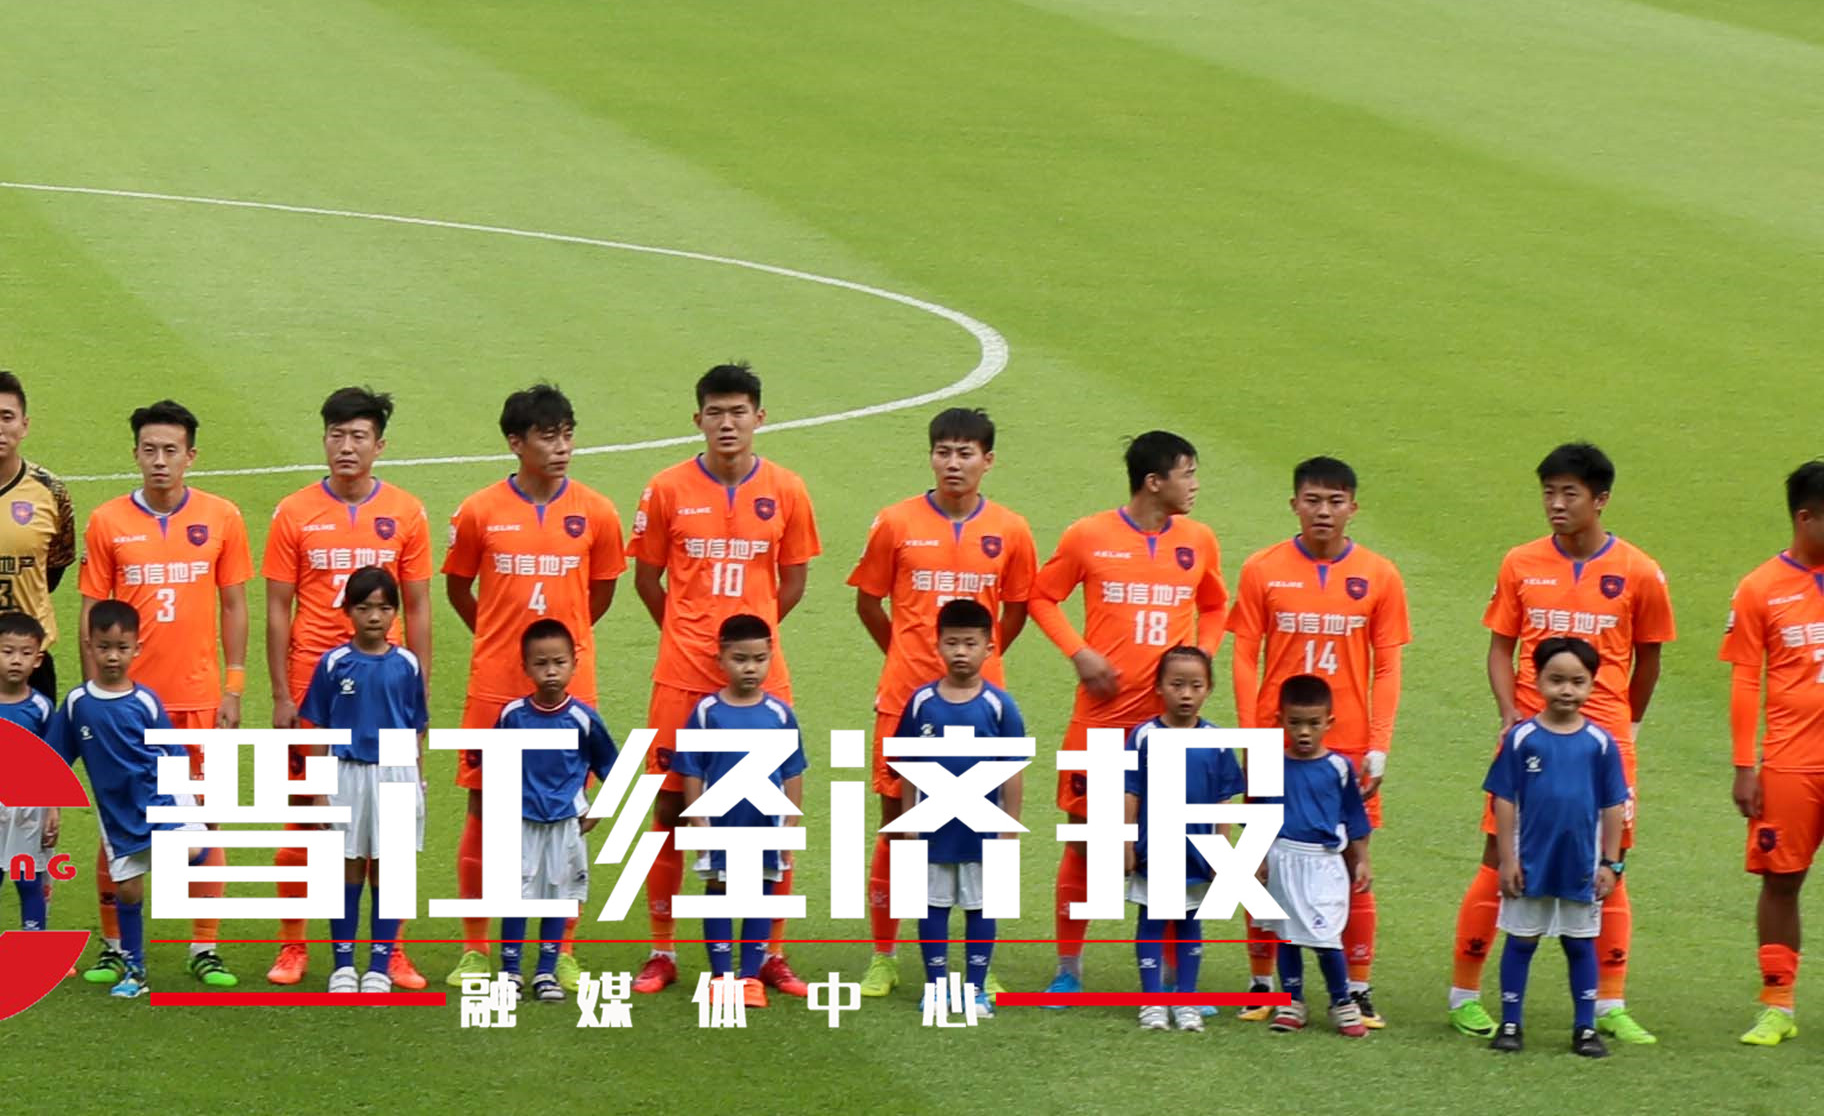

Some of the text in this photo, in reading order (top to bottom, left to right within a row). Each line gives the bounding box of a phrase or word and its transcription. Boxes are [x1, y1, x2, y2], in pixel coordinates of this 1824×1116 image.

[307, 547, 398, 571] 海信地产
[683, 537, 772, 561] 海信地产
[123, 560, 211, 586] 海信地产
[492, 553, 582, 577] 海信地产
[711, 562, 745, 598] 10
[912, 570, 998, 594] 海信地产
[1102, 580, 1196, 607] 海信地产
[156, 587, 177, 622] 3
[528, 582, 548, 616] 4
[1134, 611, 1168, 647] 18
[1274, 611, 1369, 637] 海信地产
[1528, 606, 1620, 636] 海信地产
[1304, 640, 1338, 676] 14
